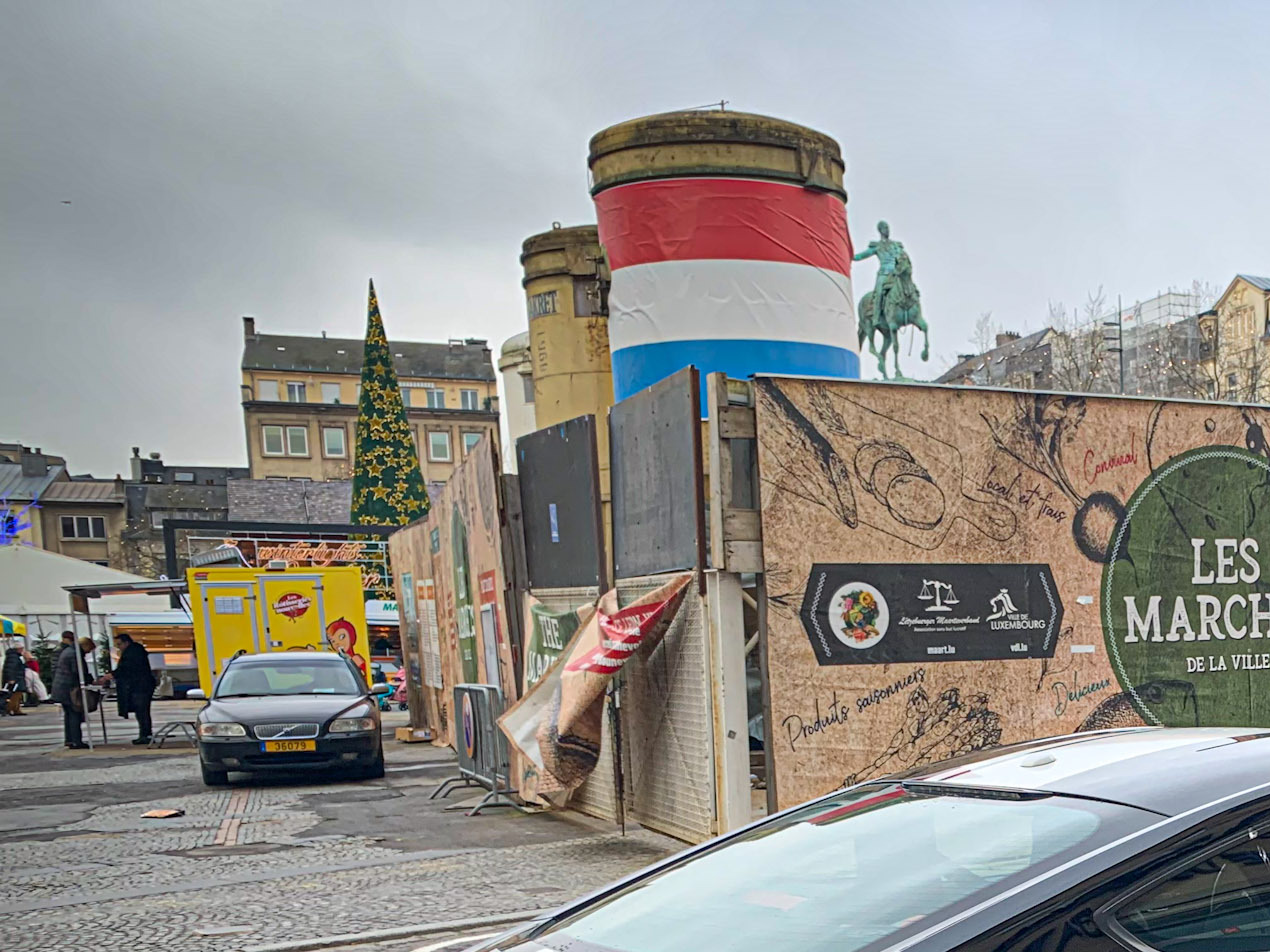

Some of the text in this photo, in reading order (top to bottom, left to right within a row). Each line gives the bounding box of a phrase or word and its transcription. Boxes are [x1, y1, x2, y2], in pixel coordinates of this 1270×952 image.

[1191, 537, 1261, 585] LES
[538, 615, 563, 650] THE
[990, 619, 1046, 630] LUXEMBOURG
[1186, 653, 1270, 673] DE LA VILLE
[782, 667, 926, 752] Produits saisonniers
